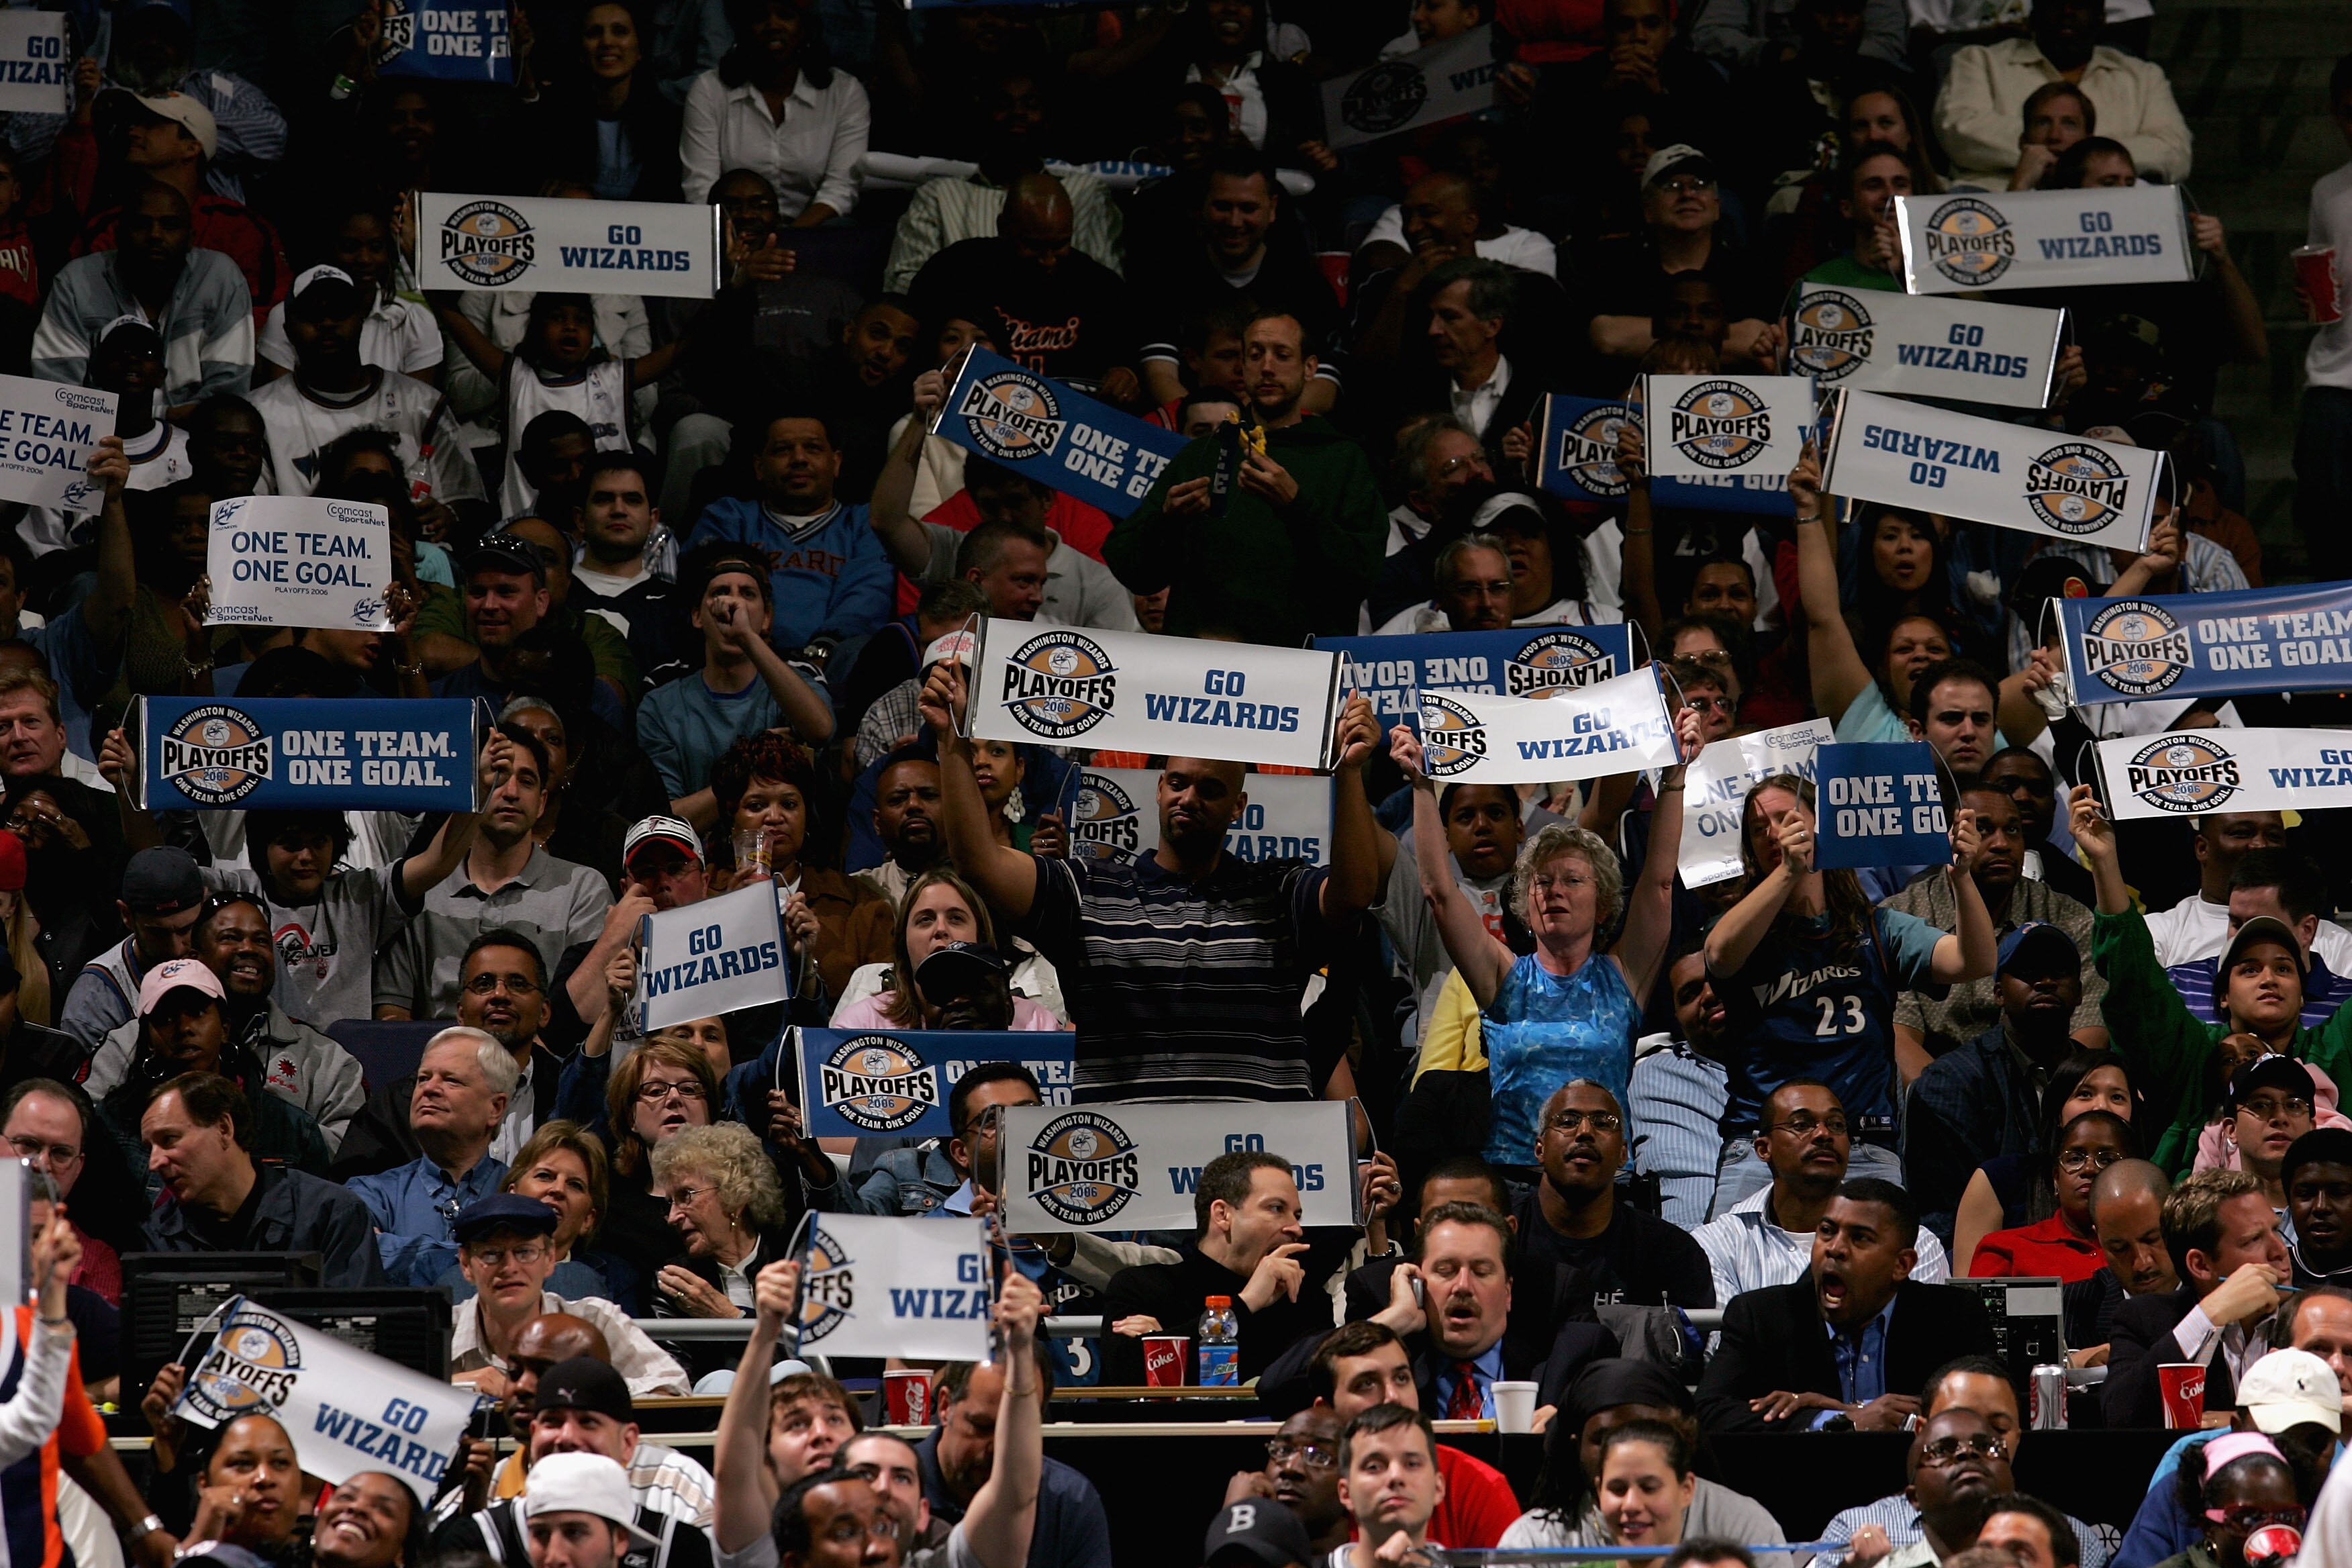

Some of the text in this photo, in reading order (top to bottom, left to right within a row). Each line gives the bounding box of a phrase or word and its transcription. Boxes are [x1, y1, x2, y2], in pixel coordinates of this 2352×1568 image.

[422, 10, 508, 32] ONE T
[28, 36, 59, 58] GO
[428, 34, 482, 57] ONE
[491, 36, 510, 58] G
[608, 226, 640, 245] GO
[2079, 212, 2112, 232] GO
[442, 229, 535, 261] PLAYOFFS
[560, 246, 690, 271] WIZARDS
[1926, 229, 2014, 260] PLAYOFFS
[2038, 234, 2162, 260] WIZARDS
[1795, 328, 1874, 357] AYOFFS
[1949, 324, 1983, 346] GO
[1898, 344, 2028, 378] WIZARDS
[66, 400, 114, 415] SportsNet
[985, 373, 1059, 416] WASHINGTON WIZARDS
[21, 412, 93, 446] TEAM.
[963, 386, 1059, 450] PLAYOFFS
[994, 423, 1017, 441] 2006
[1672, 411, 1770, 442] PLAYOFFS
[15, 440, 87, 472] GOAL.
[1070, 423, 1130, 464] ONE
[1708, 436, 1734, 448] 2006
[1864, 425, 2000, 473] WIZARDS
[1065, 448, 1124, 489] ONE
[1910, 461, 1947, 488] GO
[2026, 464, 2128, 510] PLAYOFFS
[338, 515, 385, 526] SportsNet
[232, 532, 371, 559] ONE TEAM.
[233, 560, 371, 587] ONE GOAL.
[217, 614, 273, 622] SportsNet
[2091, 602, 2175, 634] WASHINGTON WIZARDS
[2198, 616, 2259, 644] ONE
[1016, 633, 1110, 670] WASHINGTON WIZARDS
[1547, 655, 1573, 665] 2006
[2086, 634, 2189, 671] PLAYOFFS
[2208, 643, 2272, 672] ONE
[1424, 656, 1489, 684] ONE
[2101, 667, 2182, 694] ONE TEAM. ONE GOAL.
[2127, 663, 2153, 674] 2006
[1002, 663, 1116, 712] PLAYOFFS
[1204, 669, 1246, 697] GO
[1013, 704, 1101, 736] ONE TEAM. ONE GOAL.
[1042, 700, 1071, 714] 2006
[1144, 693, 1299, 733] WIZARDS
[1441, 699, 1476, 725] WIZARDS
[172, 707, 260, 737] WASHINGTON WIZARDS
[1573, 708, 1611, 735] GO
[282, 730, 457, 757] ONE TEAM.
[1426, 729, 1486, 755] OFFS
[1779, 734, 1831, 750] SportsNet
[2135, 736, 2225, 764] WASHINGTON WIZARDS
[164, 740, 268, 776] PLAYOFFS
[1434, 756, 1477, 775] ONE GOAL.
[203, 771, 230, 781] 2006
[289, 759, 451, 786] ONE GOAL.
[2127, 759, 2240, 793] PLAYOFFS
[175, 777, 260, 803] ONE TEAM. ONE GOAL.
[1097, 778, 1130, 810] WIZARDS
[1828, 775, 1894, 805] ONE
[2145, 787, 2231, 812] ONE TEAM. ONE GOAL.
[2174, 784, 2200, 794] 2006
[1698, 801, 1743, 836] ON
[1836, 807, 1903, 838] ONE
[689, 924, 722, 956] GO
[646, 941, 779, 998] WIZARDS
[1815, 995, 1866, 1036] 23
[831, 1036, 921, 1067] WASHINGTON WIZARDS
[823, 1070, 934, 1104] PLAYOFFS
[838, 1104, 925, 1129] ONE TEAM. ONE GOAL.
[867, 1098, 895, 1108] 2006
[1038, 1114, 1128, 1148] WASHINGTON WIZARDS
[1028, 1153, 1138, 1192] PLAYOFFS
[1069, 1186, 1098, 1198] 2006
[1040, 1191, 1128, 1222] ONE TEAM. ONE GOAL.
[958, 1254, 987, 1283] G
[1147, 1352, 1176, 1371] Coke
[381, 1398, 429, 1434] GO
[1226, 1504, 1256, 1534] B
